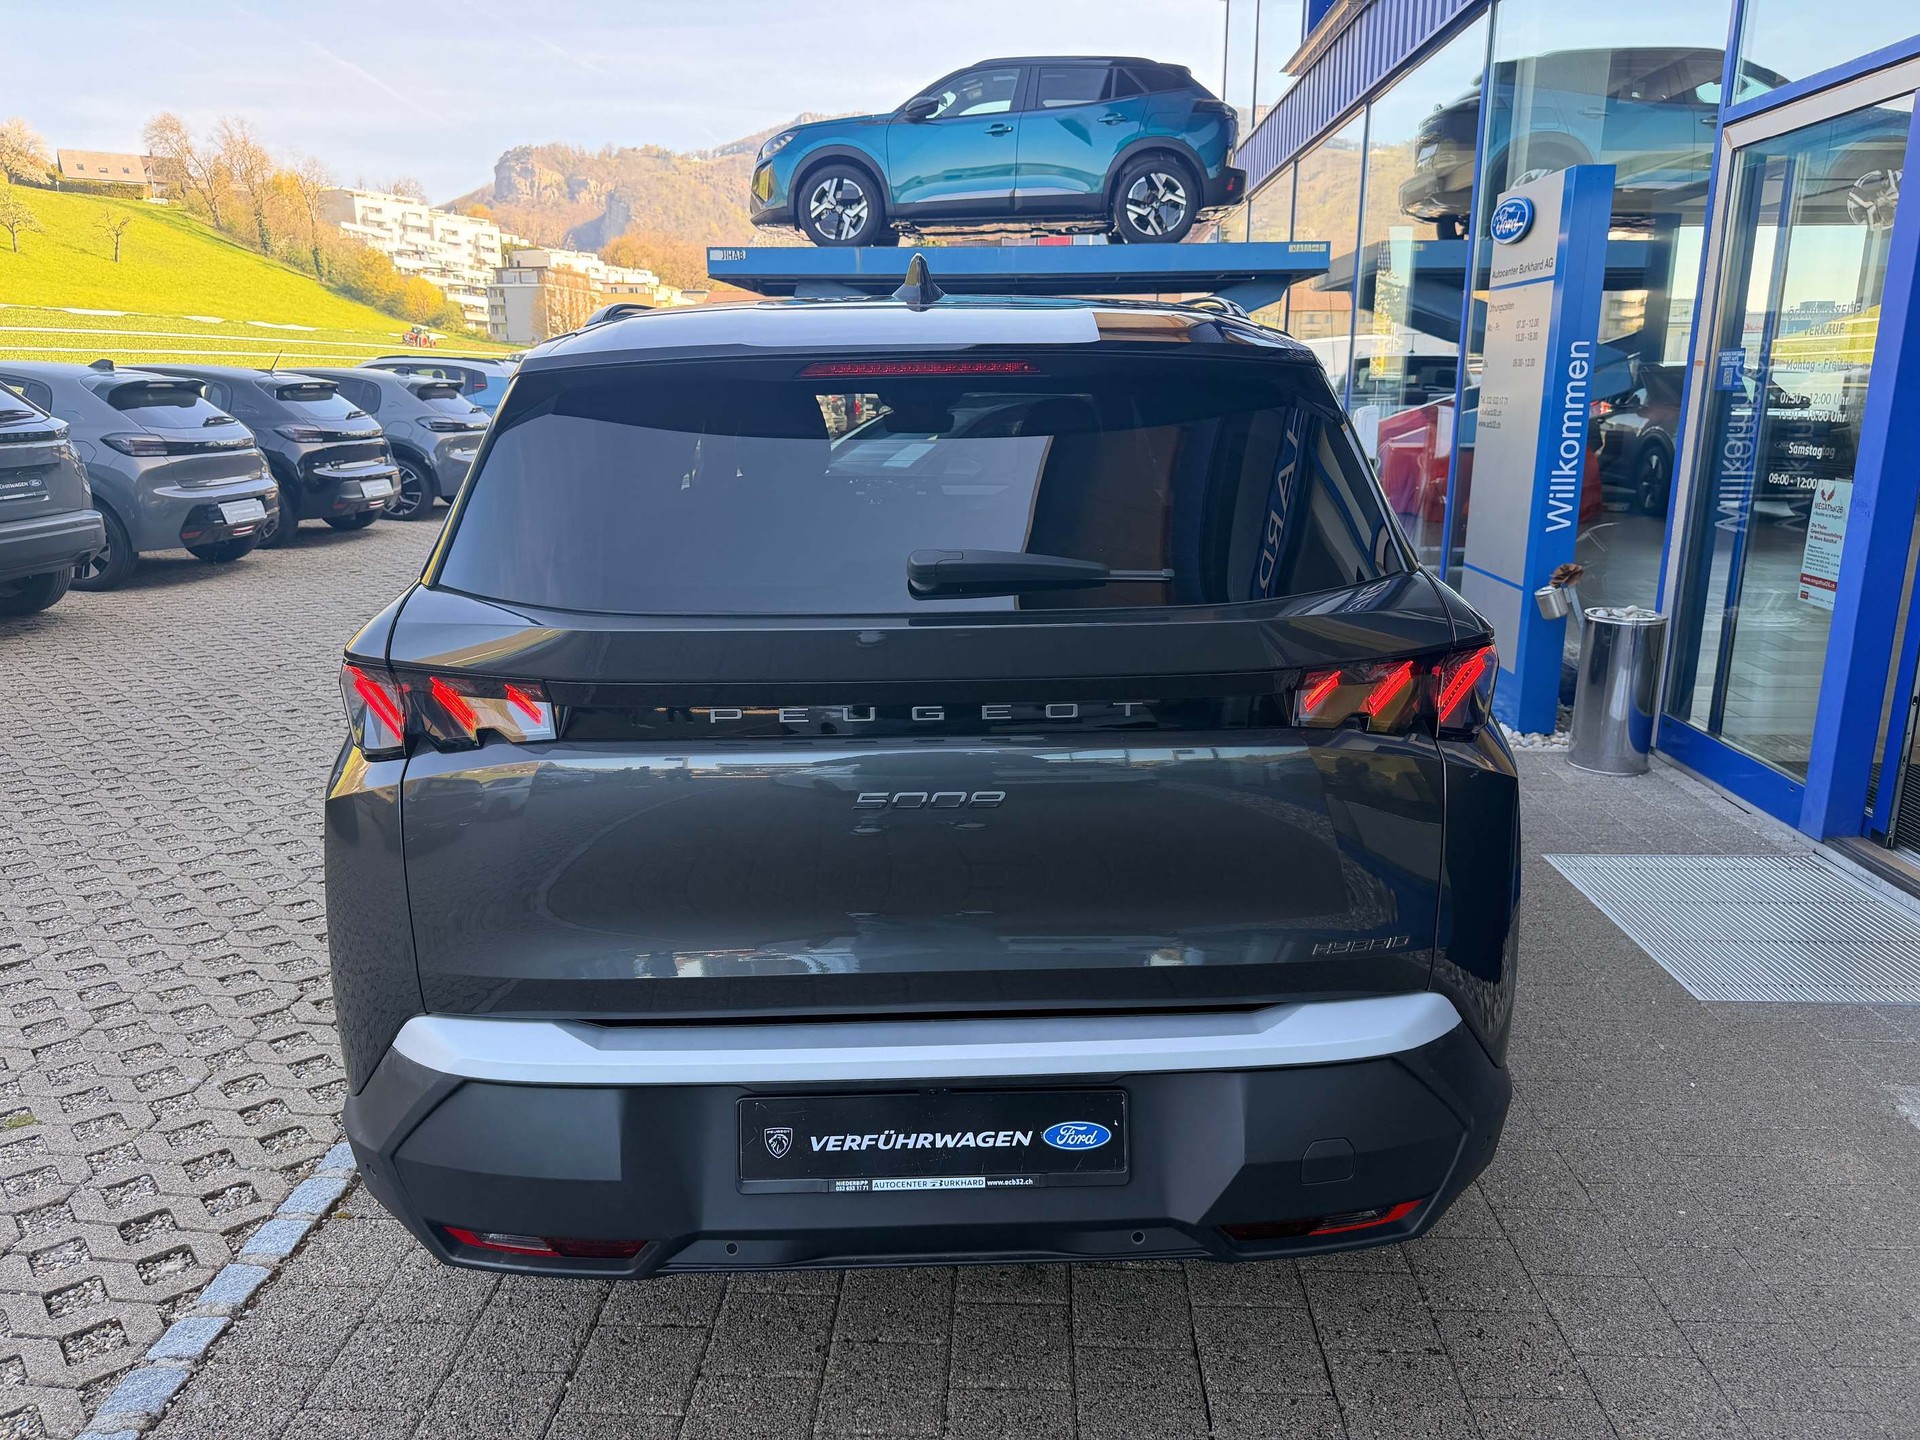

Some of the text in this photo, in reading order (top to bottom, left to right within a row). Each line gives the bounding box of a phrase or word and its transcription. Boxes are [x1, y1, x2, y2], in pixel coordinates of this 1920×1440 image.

[1494, 205, 1525, 235] Ford
[1491, 257, 1554, 279] Autocenter Burkhard AG
[1804, 323, 1846, 337] VERKAUF
[1785, 359, 1816, 373] Montag
[1823, 358, 1854, 373] Freitag
[1810, 393, 1832, 405] 12:00
[1834, 393, 1850, 406] Uhr
[1830, 410, 1848, 423] Uhr
[1545, 340, 1591, 533] Willkommen
[1788, 441, 1823, 460] Samstag
[1768, 473, 1790, 486] 09:00
[1796, 477, 1818, 490] 12:00
[709, 701, 1144, 723] PEUGEOT
[853, 791, 1007, 810] 5008
[1312, 935, 1411, 955] HYBRID
[810, 1130, 1034, 1151] VERFÜHRWAGEN
[1056, 1126, 1098, 1146] Ford
[873, 1180, 928, 1189] AUTOCENTER
